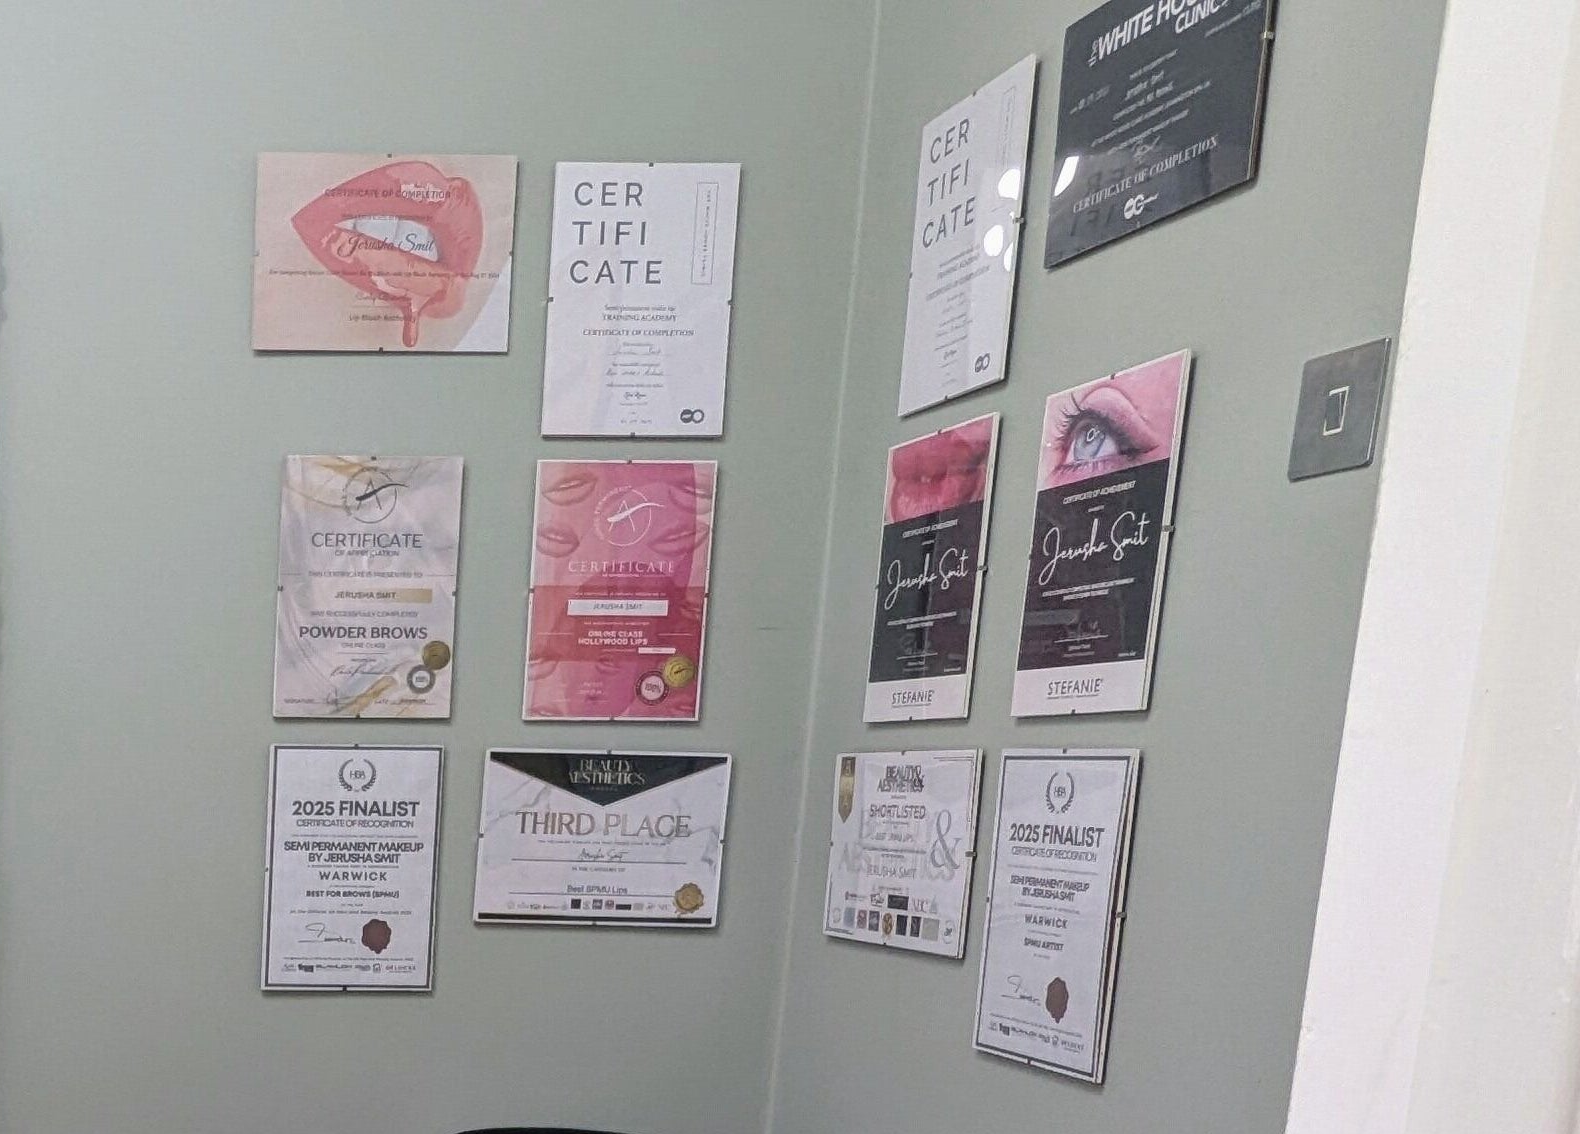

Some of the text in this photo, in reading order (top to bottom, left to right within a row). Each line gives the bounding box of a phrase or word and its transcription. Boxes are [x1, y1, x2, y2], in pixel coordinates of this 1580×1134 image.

[1098, 4, 1155, 60] WHITE
[1155, 0, 1198, 26] HO
[930, 118, 970, 164] CER
[927, 159, 970, 206] TIFI
[574, 181, 644, 207] CER
[922, 196, 976, 248] CATE
[571, 220, 647, 246] TIFI
[569, 259, 663, 285] CATE
[311, 531, 424, 549] CERTIFICATE
[1110, 510, 1151, 562] Smit
[568, 559, 675, 573] CERTIFICATE
[299, 626, 428, 640] POWDER BROWS
[1047, 679, 1101, 696] STEFANIE
[891, 690, 932, 705] STEFANIE
[580, 759, 633, 772] BEAUTY
[569, 771, 646, 785] AESTHETICS
[292, 800, 420, 817] 2025 FINALIST
[869, 804, 927, 820] SHORTLISTED
[296, 819, 345, 828] CERTIFICATE
[358, 820, 414, 829] RECOGNITION
[515, 811, 693, 838] THIRD PLACE
[1008, 822, 1106, 849] 2025 FINALIST
[284, 840, 425, 853] SEMI PERMANENT MAKEUP
[308, 852, 401, 864] BY JERUSHA SMIT
[319, 871, 388, 881] WARWICK
[305, 890, 325, 898] BEST
[326, 890, 342, 898] FOR
[342, 890, 372, 898] BROWS
[1024, 914, 1069, 930] WARWICK
